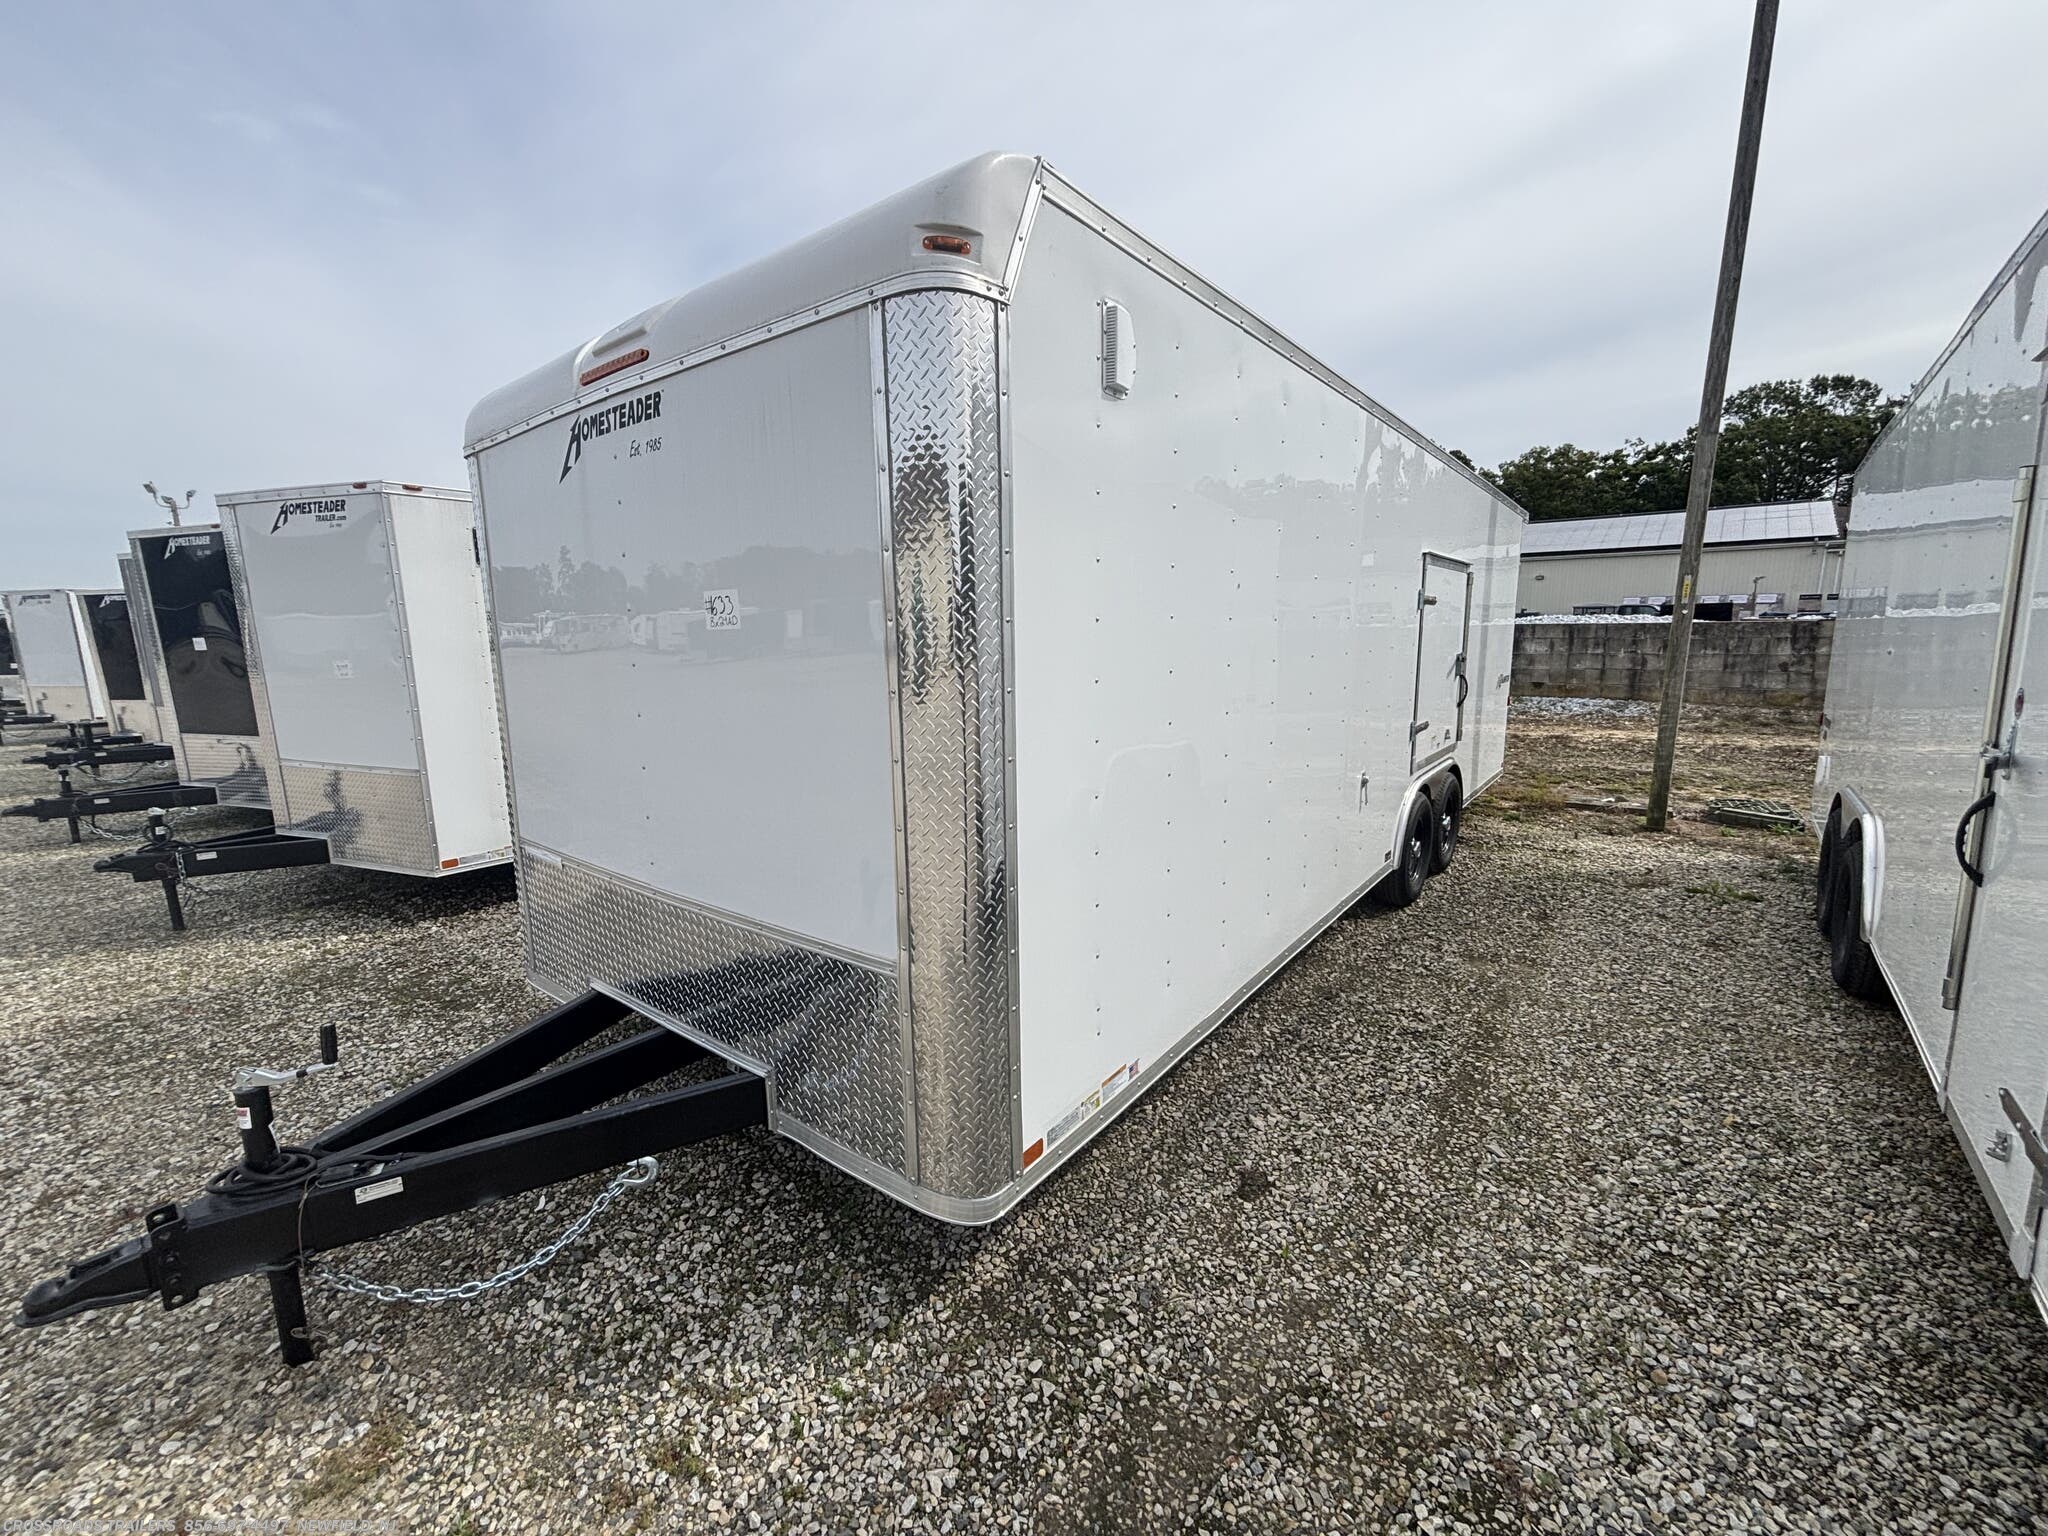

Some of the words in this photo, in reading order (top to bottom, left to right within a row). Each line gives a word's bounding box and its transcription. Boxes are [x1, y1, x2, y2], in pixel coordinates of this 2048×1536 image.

[560, 391, 662, 484] HOMESTEADER
[645, 437, 662, 454] 1985
[271, 499, 346, 535] HOMESTEADER
